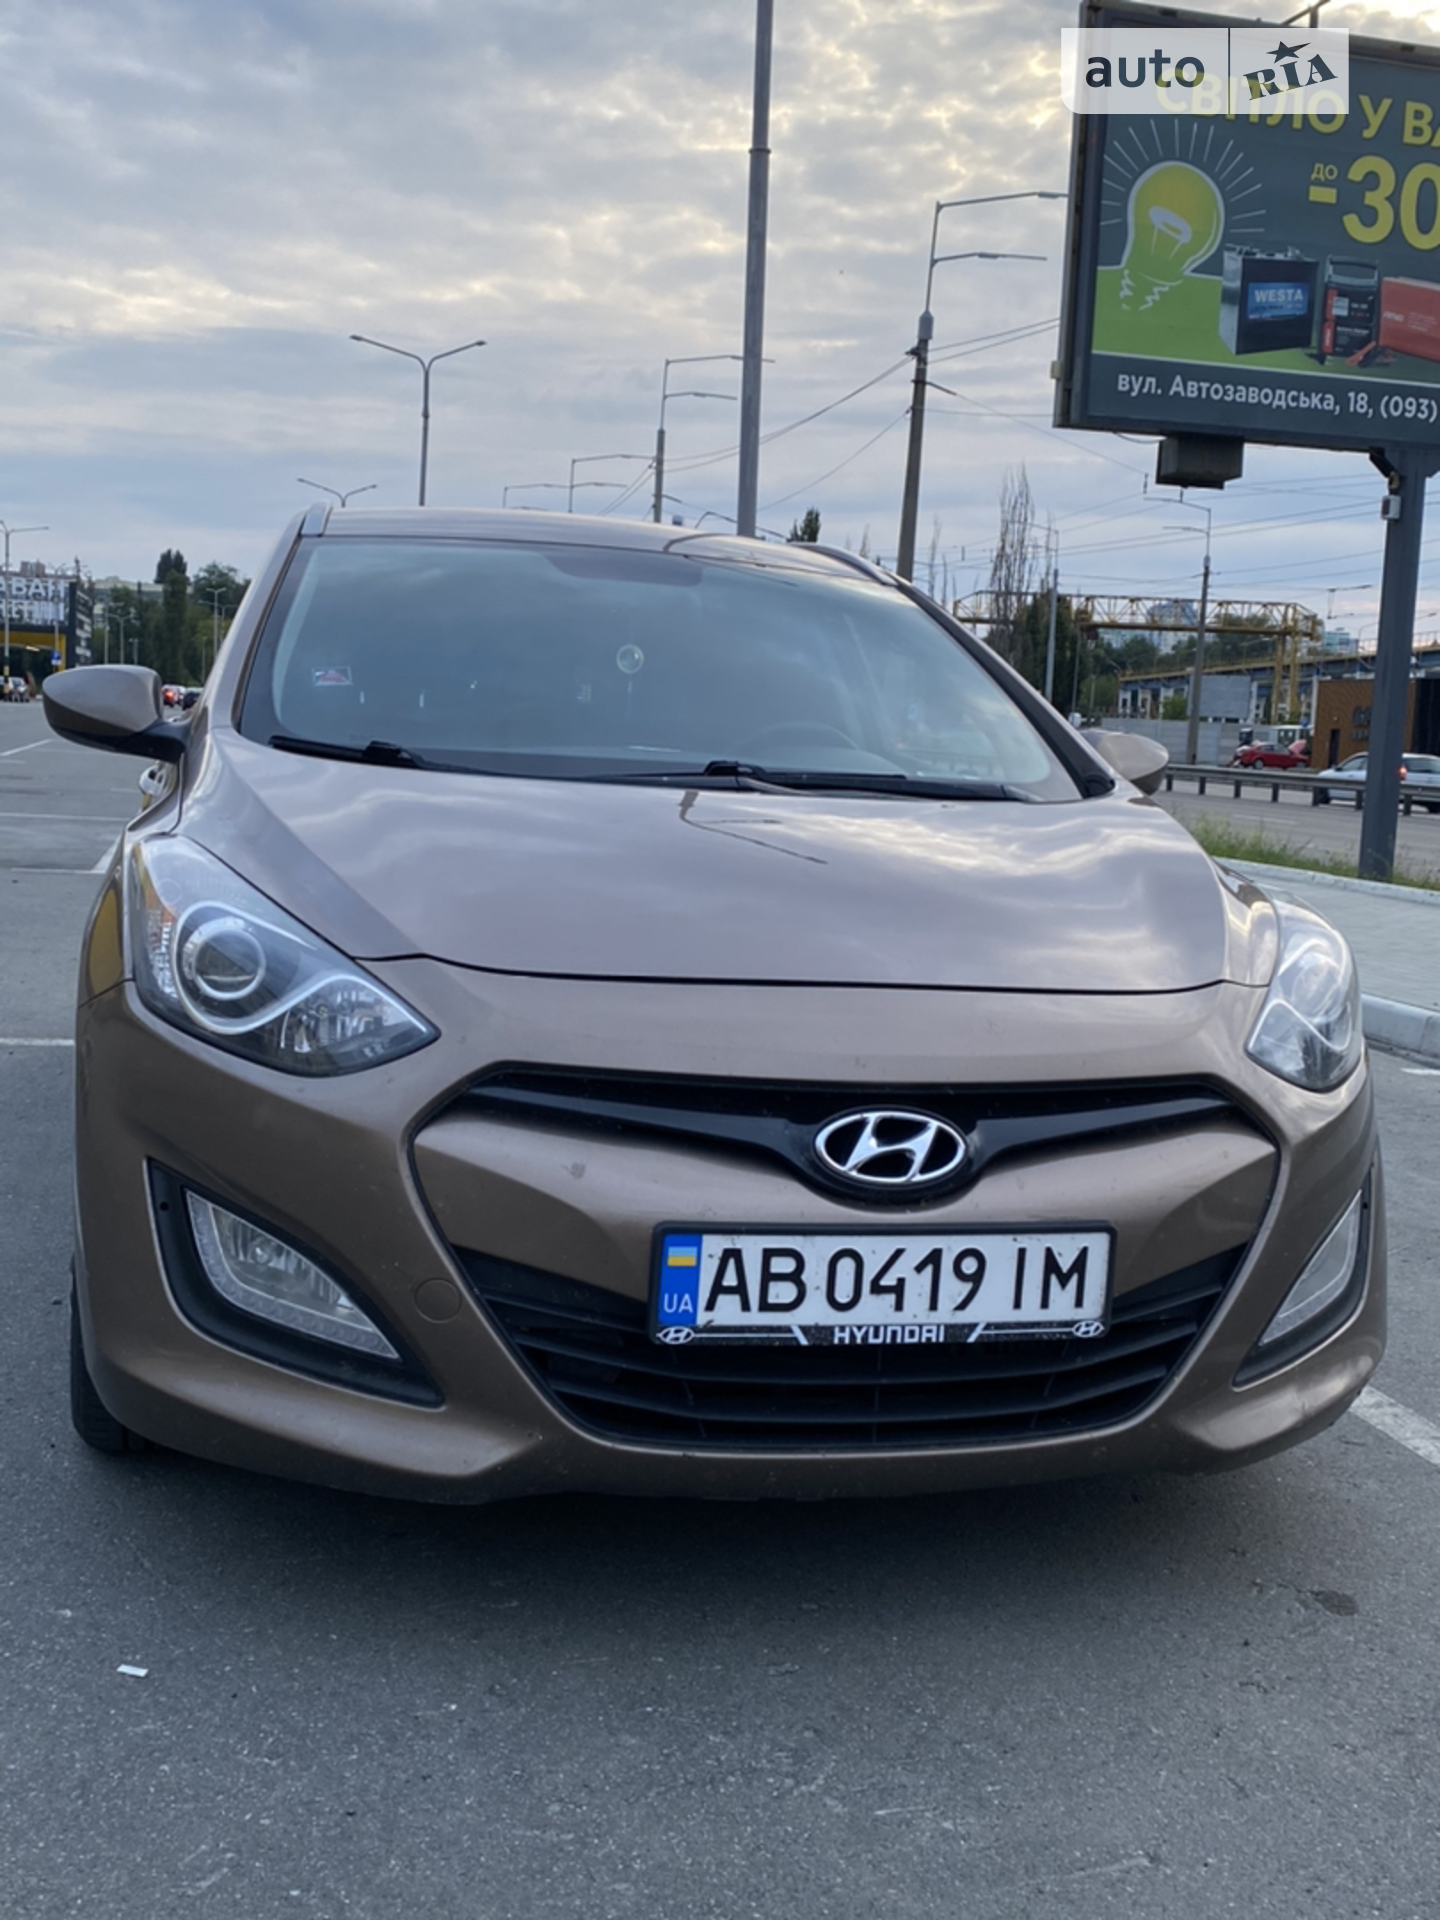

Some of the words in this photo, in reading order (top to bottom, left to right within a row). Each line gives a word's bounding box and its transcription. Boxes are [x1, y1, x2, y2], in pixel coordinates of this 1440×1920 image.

[1358, 94, 1393, 139] У
[1254, 288, 1304, 304] WESTA
[1117, 373, 1162, 397] вул.
[1169, 374, 1341, 415] Автозаводська,
[1347, 391, 1374, 418] 18,
[1380, 393, 1439, 424] (093)
[704, 1247, 807, 1313] AB
[826, 1247, 987, 1313] 0419
[1012, 1245, 1089, 1310] IM
[663, 1293, 694, 1314] UA
[833, 1324, 945, 1345] HYUNDAI
